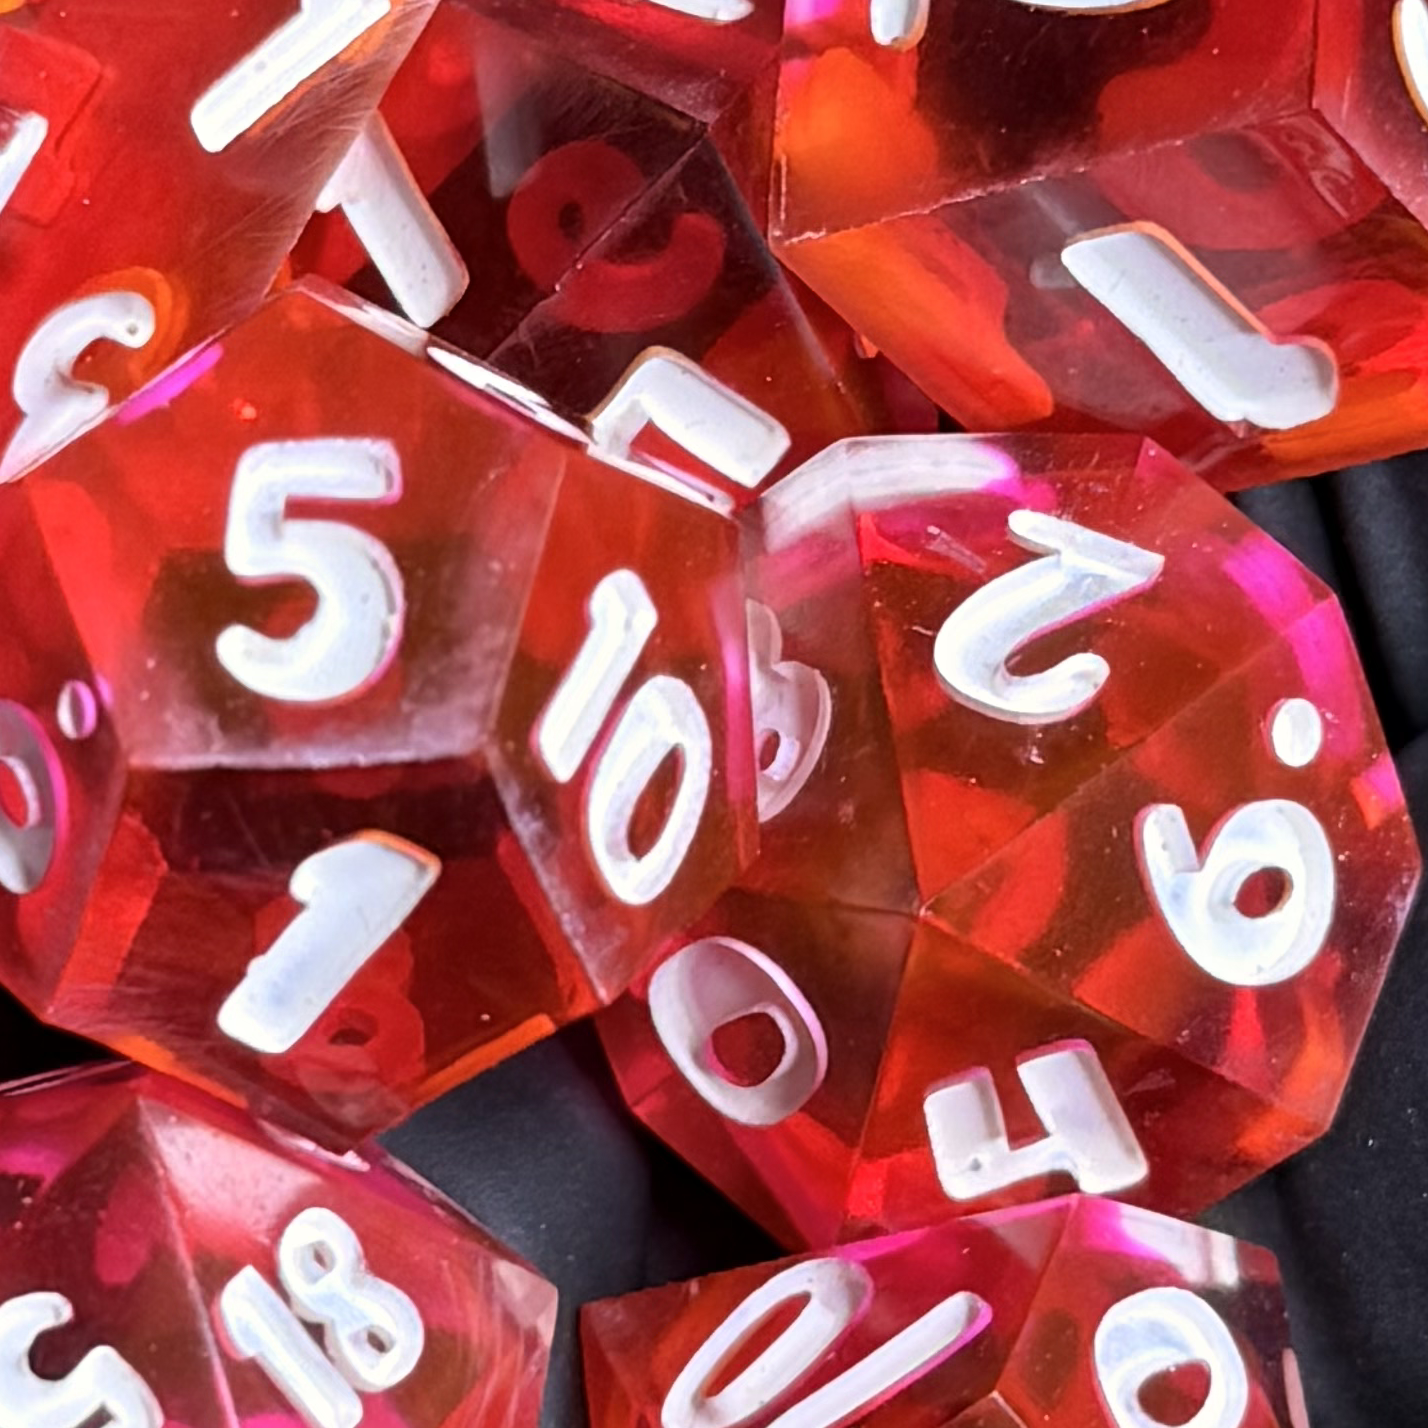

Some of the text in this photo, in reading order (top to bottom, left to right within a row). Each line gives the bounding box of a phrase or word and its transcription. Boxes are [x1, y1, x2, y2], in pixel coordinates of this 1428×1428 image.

[1059, 220, 1340, 431] 1
[214, 436, 404, 704] 5
[933, 508, 1165, 725] 2
[530, 568, 714, 908] 10
[214, 828, 444, 1056] 1
[647, 934, 829, 1128] 0
[922, 1038, 1150, 1203] 4
